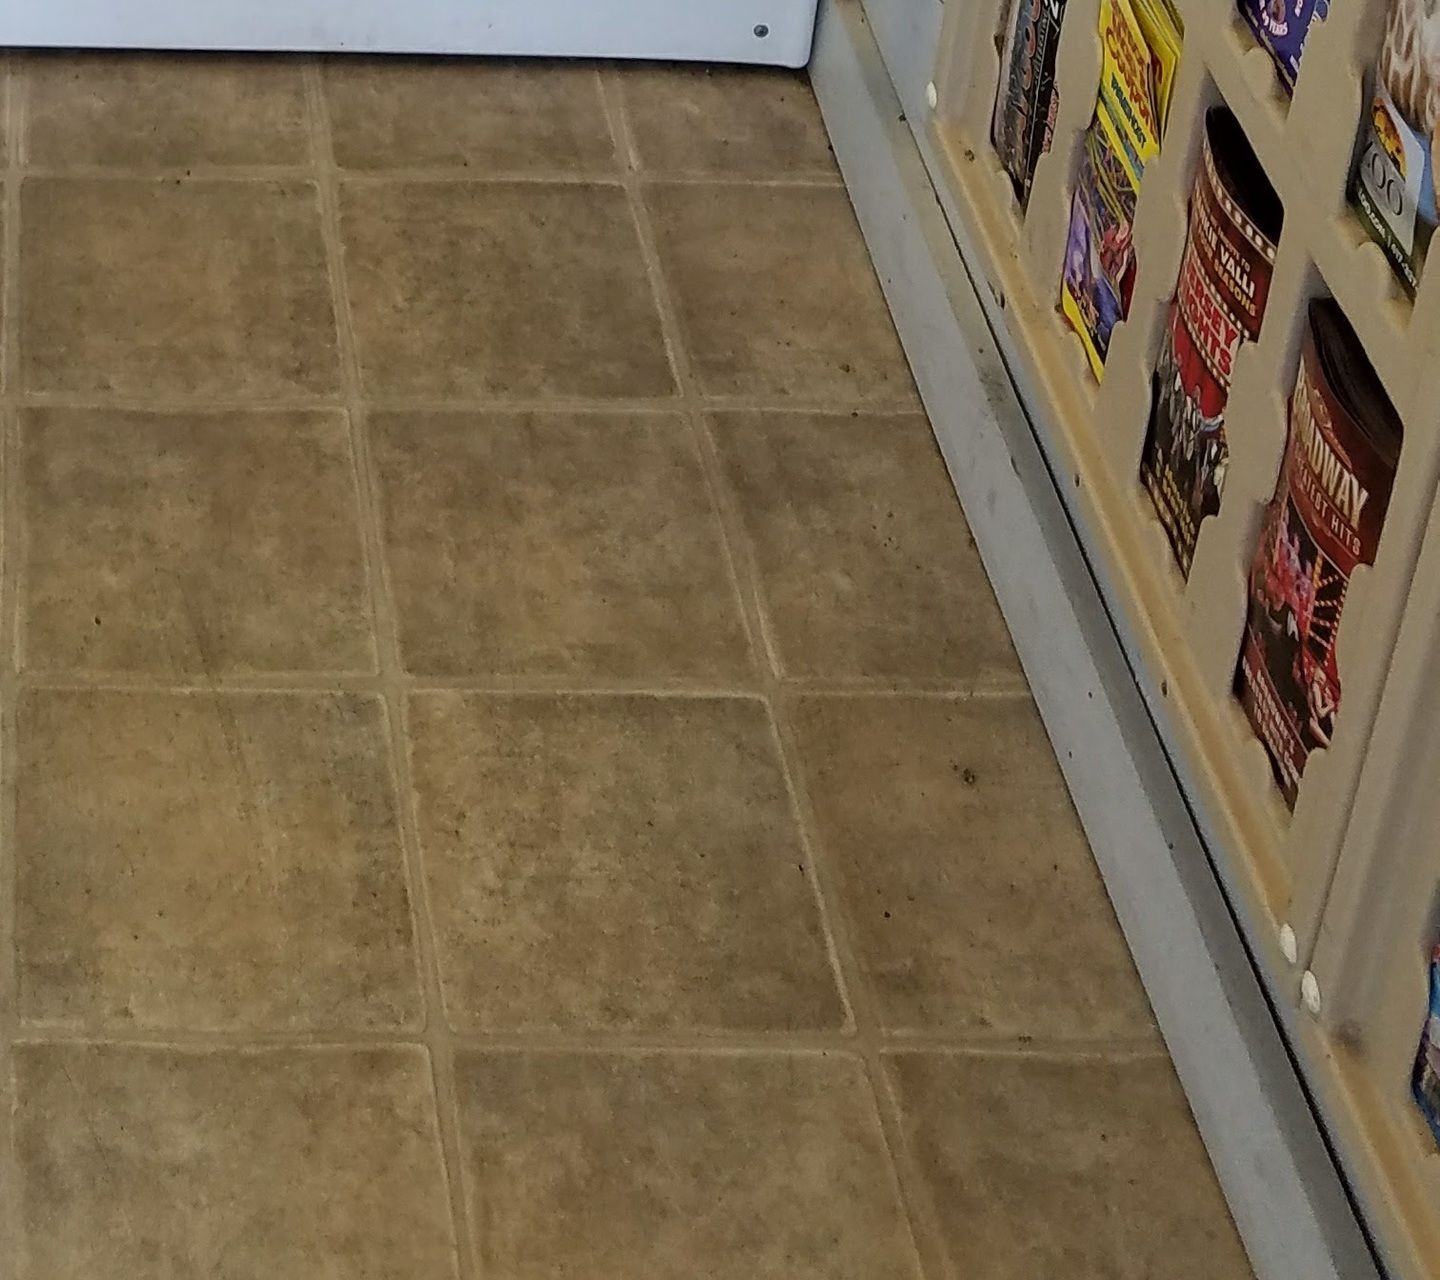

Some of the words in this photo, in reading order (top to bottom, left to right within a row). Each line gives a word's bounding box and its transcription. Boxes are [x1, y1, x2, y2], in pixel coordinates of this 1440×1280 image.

[1218, 244, 1256, 298] VALLI
[1184, 255, 1238, 349] ERSEY
[1330, 513, 1362, 557] HITS
